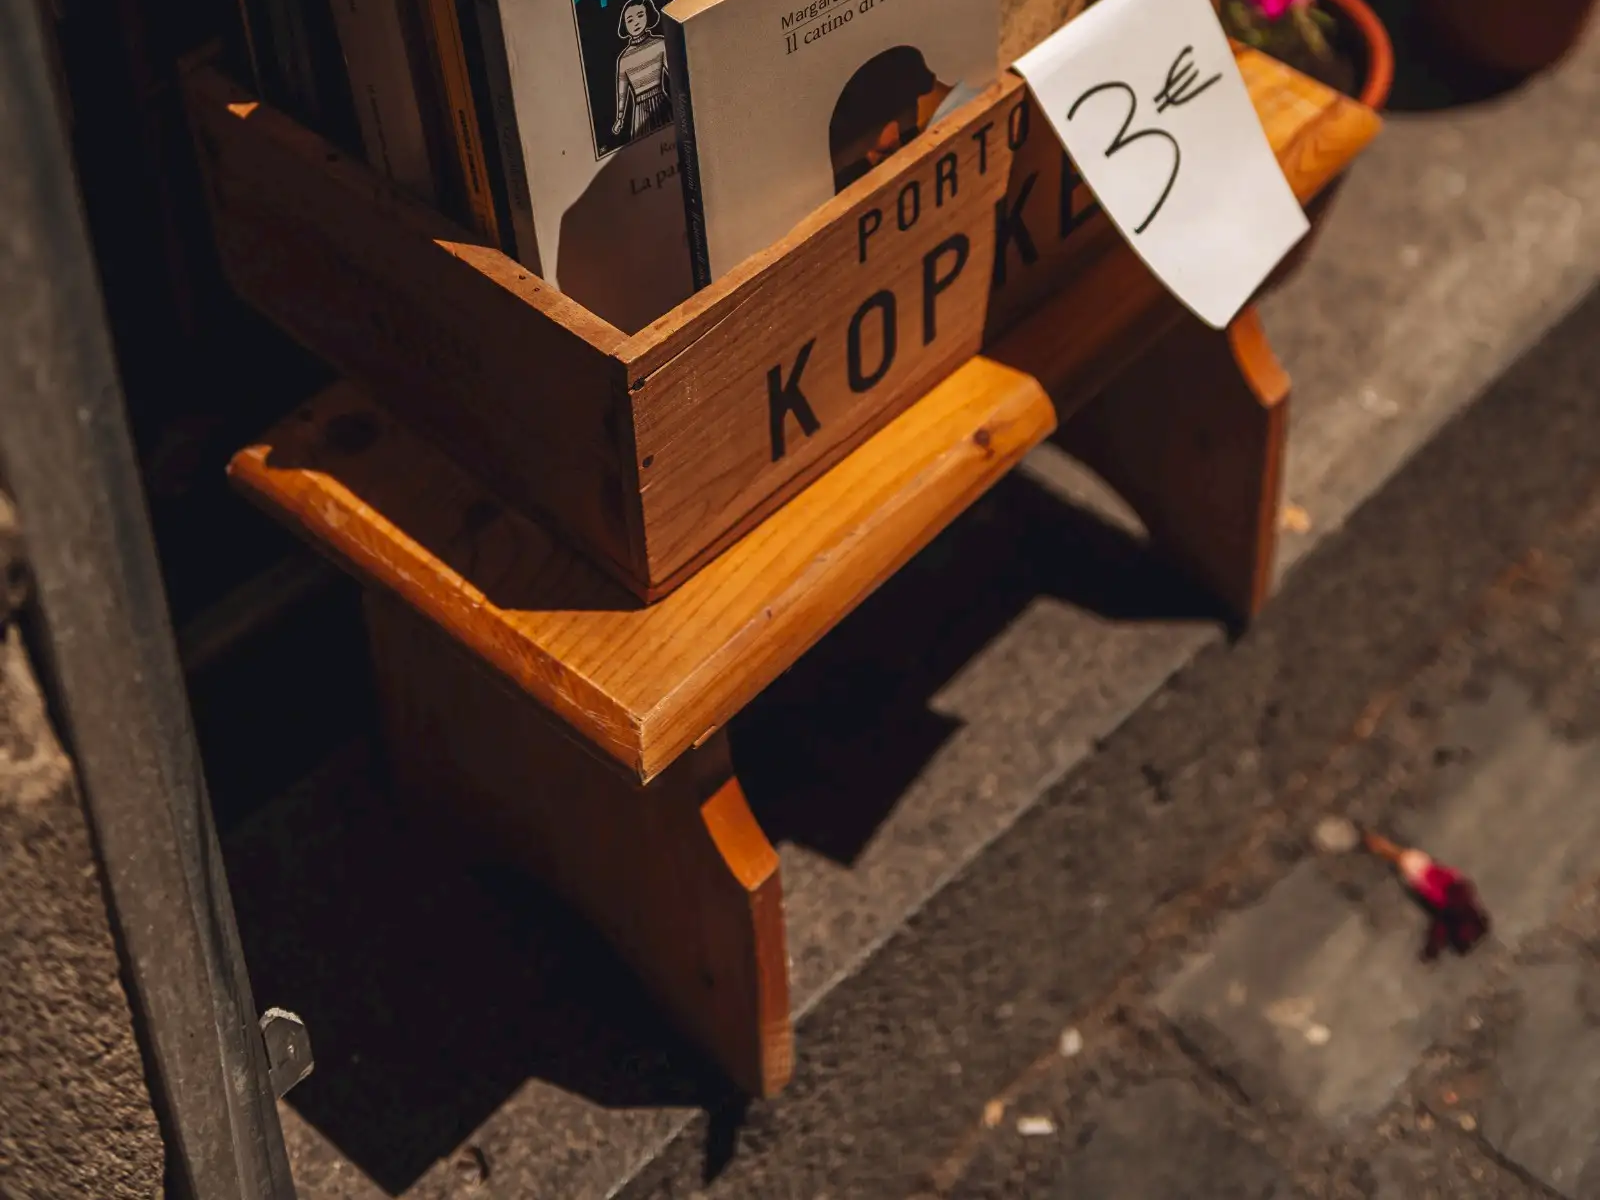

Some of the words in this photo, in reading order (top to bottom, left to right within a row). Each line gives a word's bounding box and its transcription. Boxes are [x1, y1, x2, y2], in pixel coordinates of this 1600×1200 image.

[785, 33, 799, 55] Il
[803, 8, 854, 45] catino
[628, 175, 652, 196] La
[856, 101, 1030, 265] PORTO
